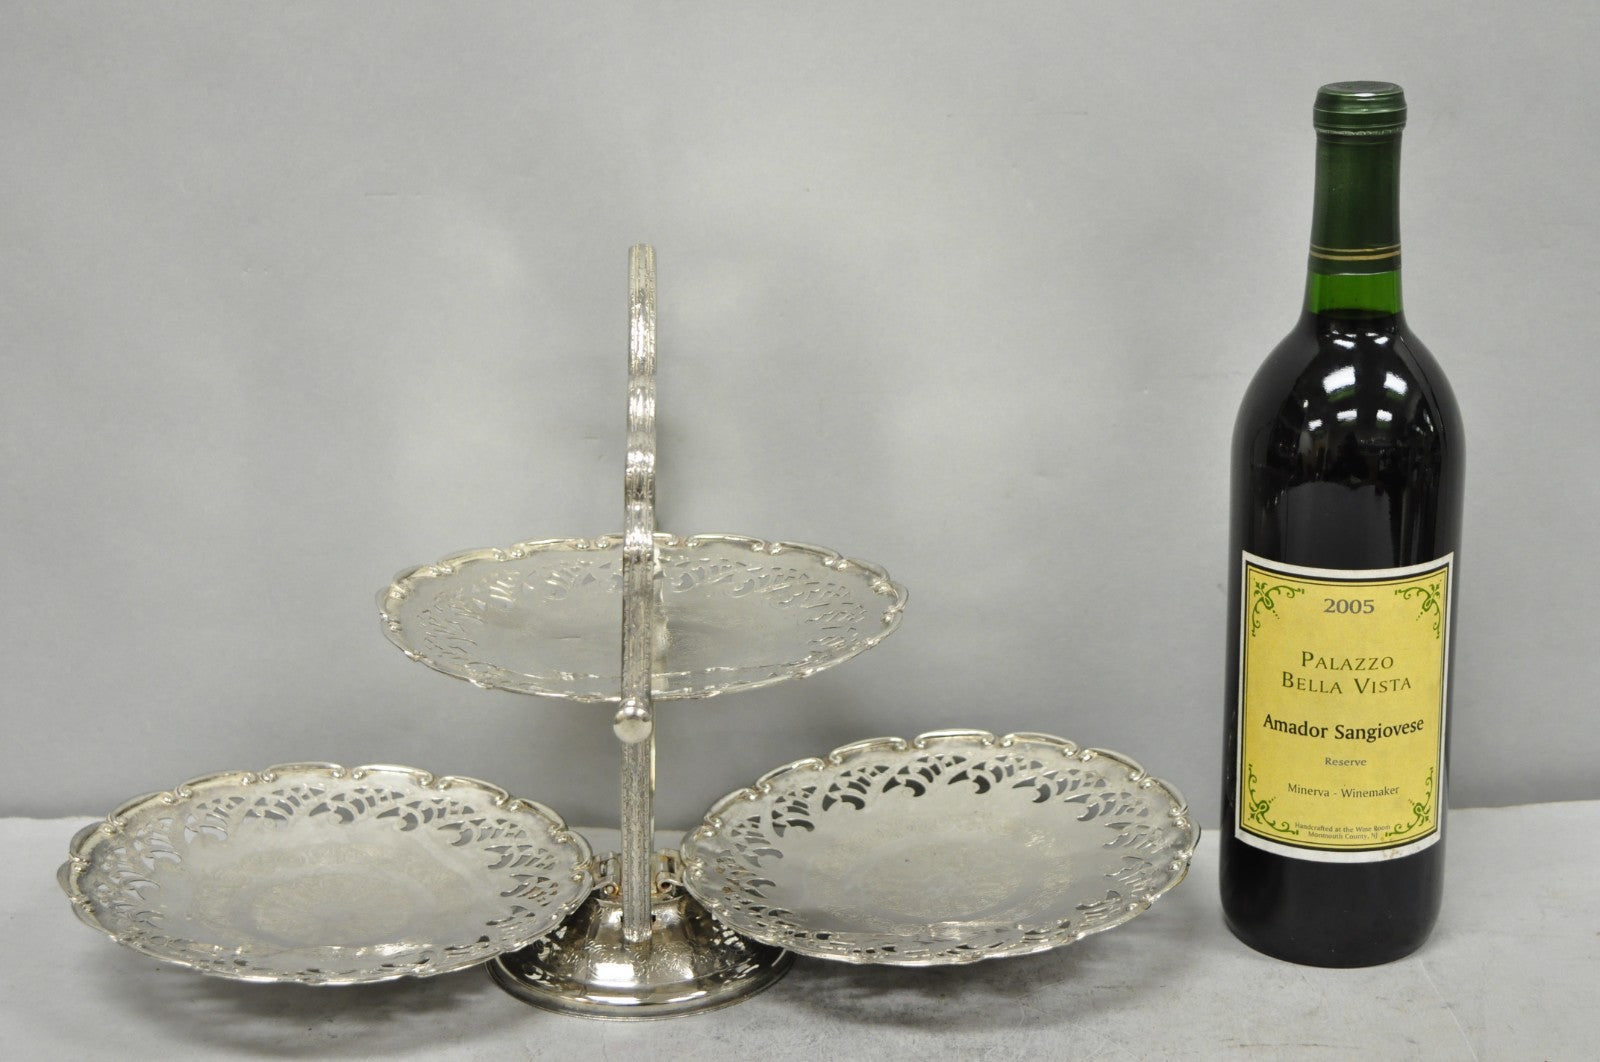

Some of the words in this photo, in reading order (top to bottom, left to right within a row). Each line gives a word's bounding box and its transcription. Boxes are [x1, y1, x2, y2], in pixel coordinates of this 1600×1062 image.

[1323, 598, 1375, 614] 2005
[1301, 650, 1394, 671] PALAZZO
[1282, 671, 1343, 694] BELLA
[1354, 677, 1412, 694] VISTA
[1263, 714, 1329, 738] Amador
[1334, 719, 1424, 743] Sangiovese
[1324, 757, 1367, 767] Reserve
[1288, 783, 1330, 797] Minerva
[1341, 786, 1400, 798] Winemaker
[1295, 822, 1333, 832] Handcrafted
[1343, 825, 1354, 833] the
